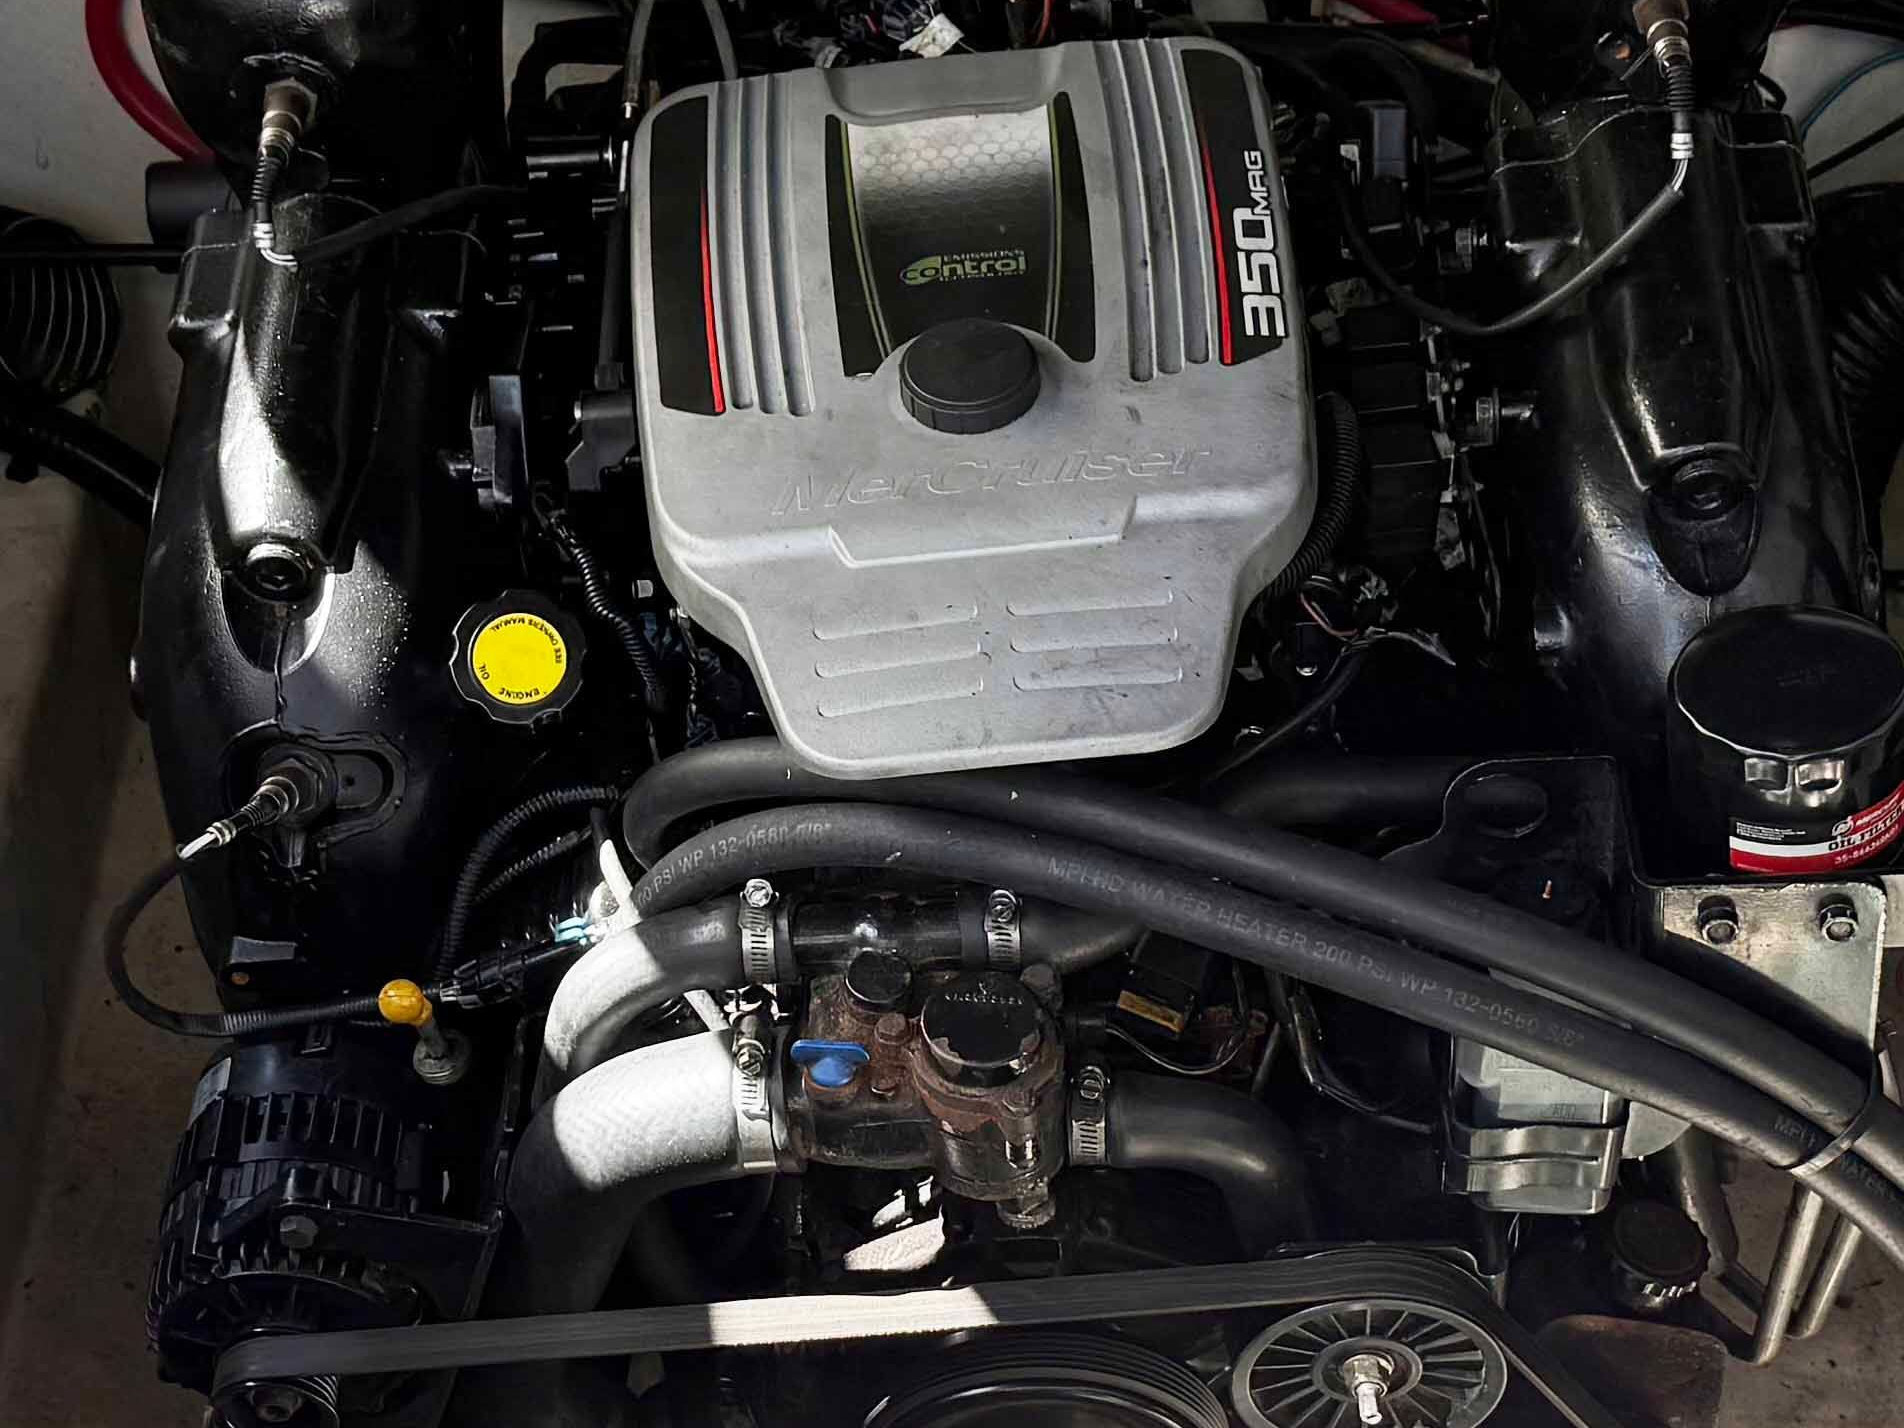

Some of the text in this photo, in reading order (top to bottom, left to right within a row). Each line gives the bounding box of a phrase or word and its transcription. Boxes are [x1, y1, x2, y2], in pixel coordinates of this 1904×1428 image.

[1233, 150, 1286, 338] 350 MAG
[479, 663, 490, 680] OIL
[1828, 835, 1856, 851] OIL
[653, 866, 676, 890] PSI
[678, 851, 705, 873] WP
[1132, 883, 1211, 923] WATER
[1216, 907, 1307, 957] HEATER
[1312, 940, 1353, 965] 200
